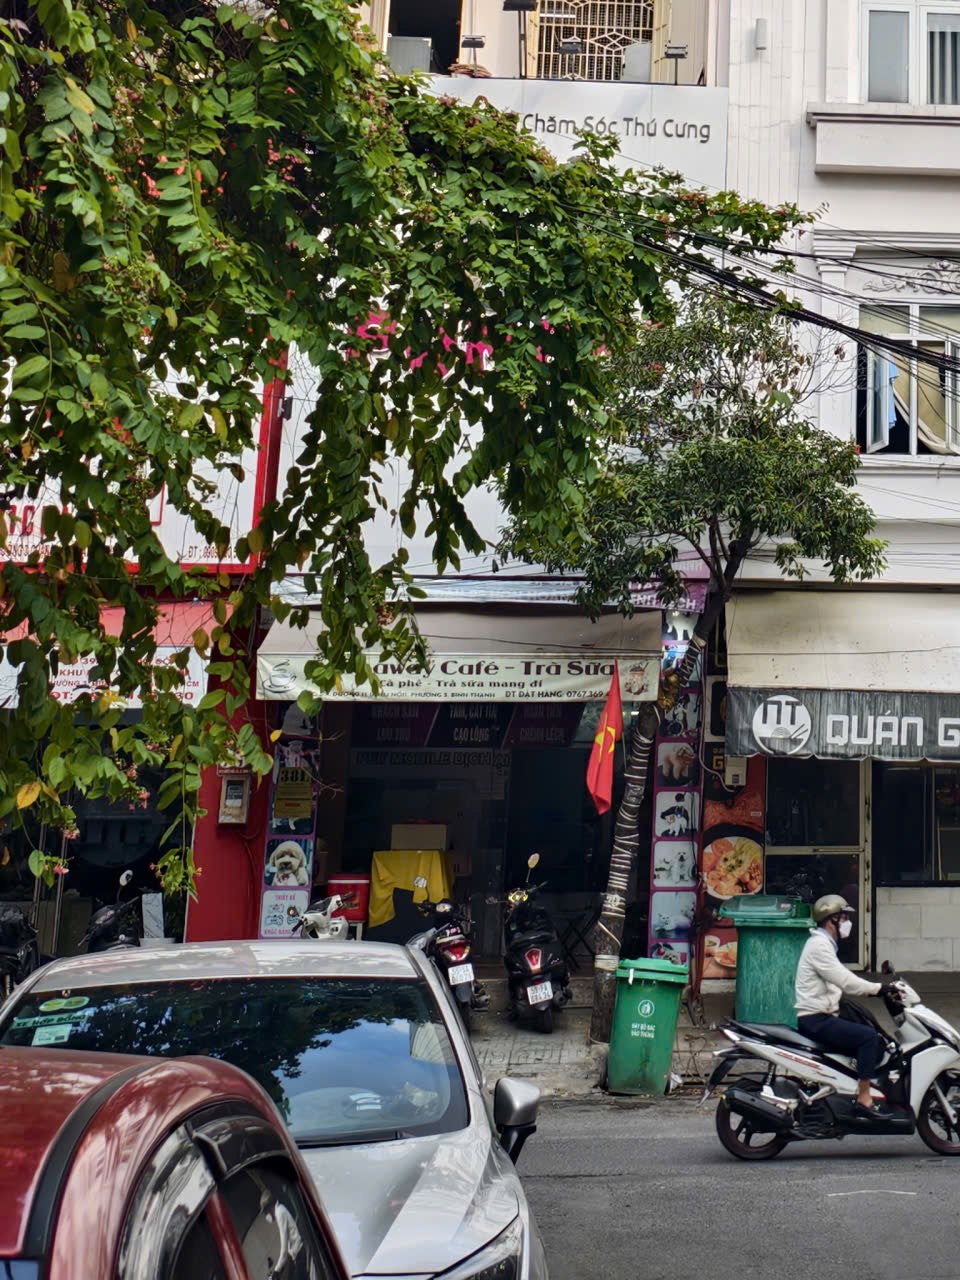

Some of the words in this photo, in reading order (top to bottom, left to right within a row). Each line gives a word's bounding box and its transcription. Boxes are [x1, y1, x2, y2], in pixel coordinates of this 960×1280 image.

[522, 113, 576, 134] Chăm
[583, 115, 618, 136] Sóc
[622, 116, 657, 137] Thú
[663, 119, 711, 144] Cưng
[520, 660, 561, 676] Trà
[567, 660, 615, 676] Sữa
[489, 680, 525, 689] mang
[826, 709, 924, 746] QUÁN
